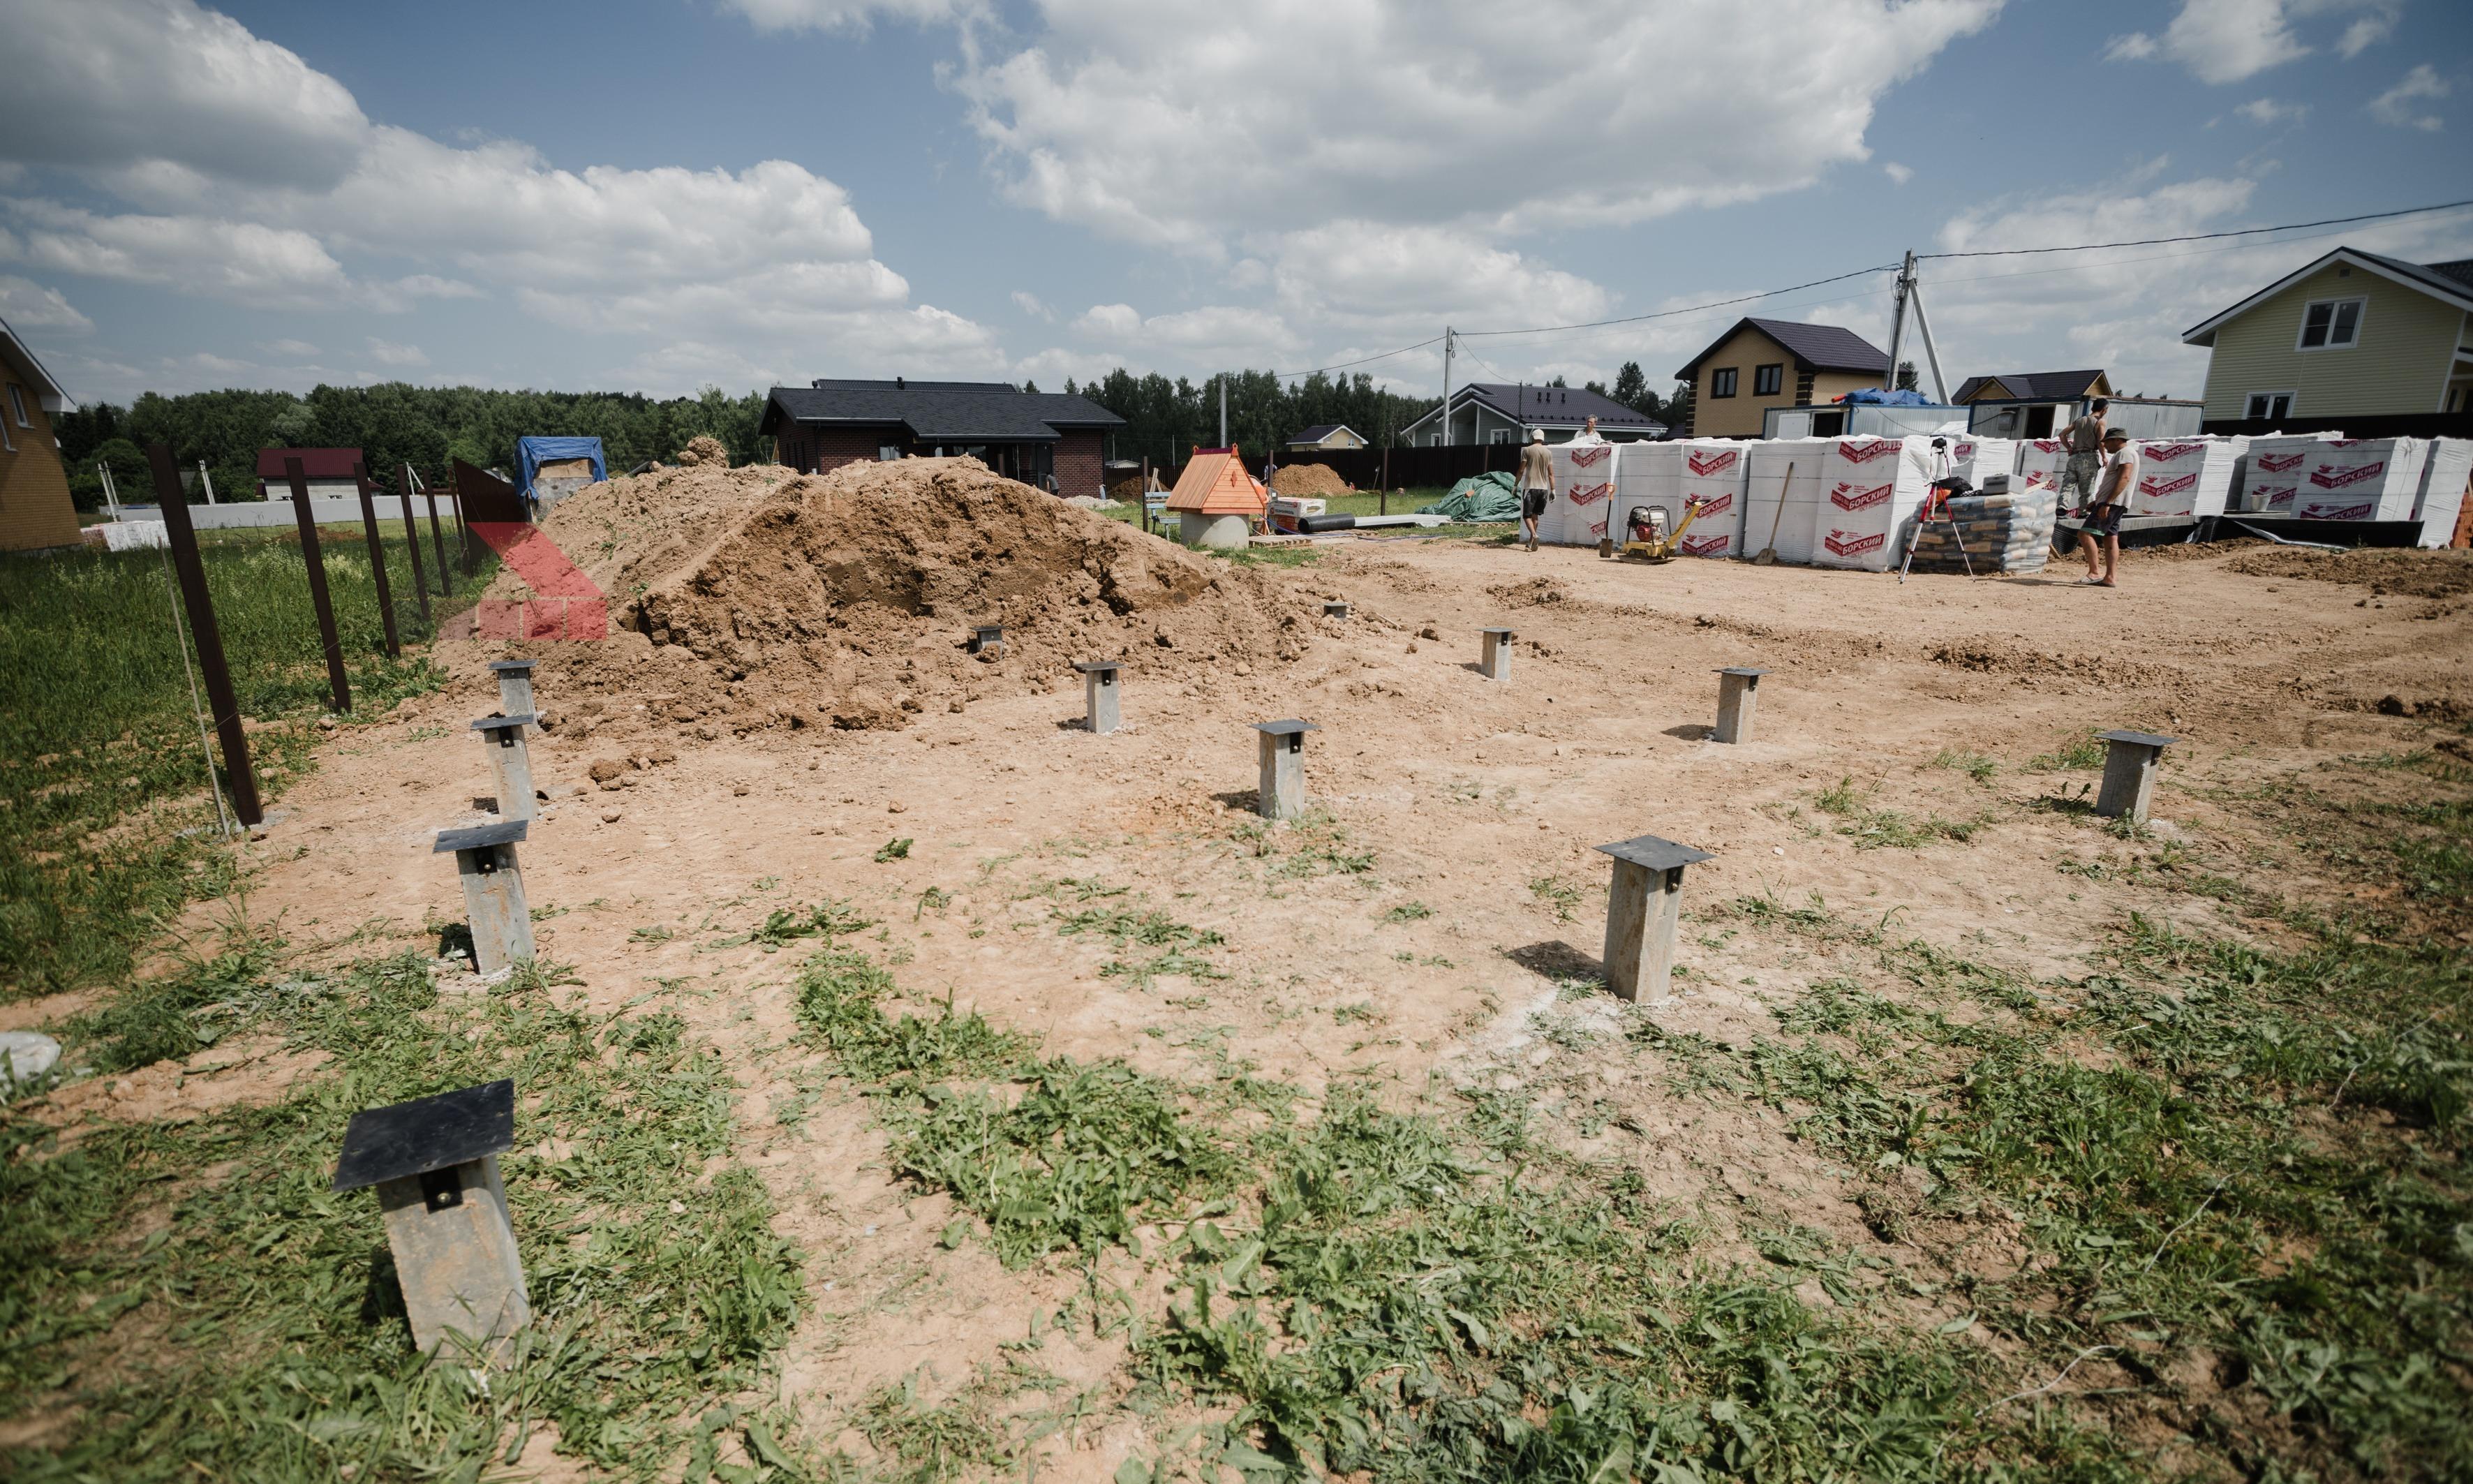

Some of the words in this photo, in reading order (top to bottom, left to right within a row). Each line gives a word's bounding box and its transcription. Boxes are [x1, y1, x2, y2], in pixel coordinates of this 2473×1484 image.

[1703, 452, 1732, 475] БОРСКИЙ
[2275, 456, 2303, 470] БОРСК
[2331, 461, 2379, 487] БОРСКИЙ
[1581, 484, 1605, 504] БОРСКИЙ
[2156, 475, 2194, 496] БОРСКИЙ
[1699, 496, 1730, 517] БОРСКИЙ
[1849, 486, 1889, 510] БОРСКИЙ
[2324, 505, 2368, 519] ОРСКИЙ
[1843, 535, 1882, 555] БОРСКИЙ
